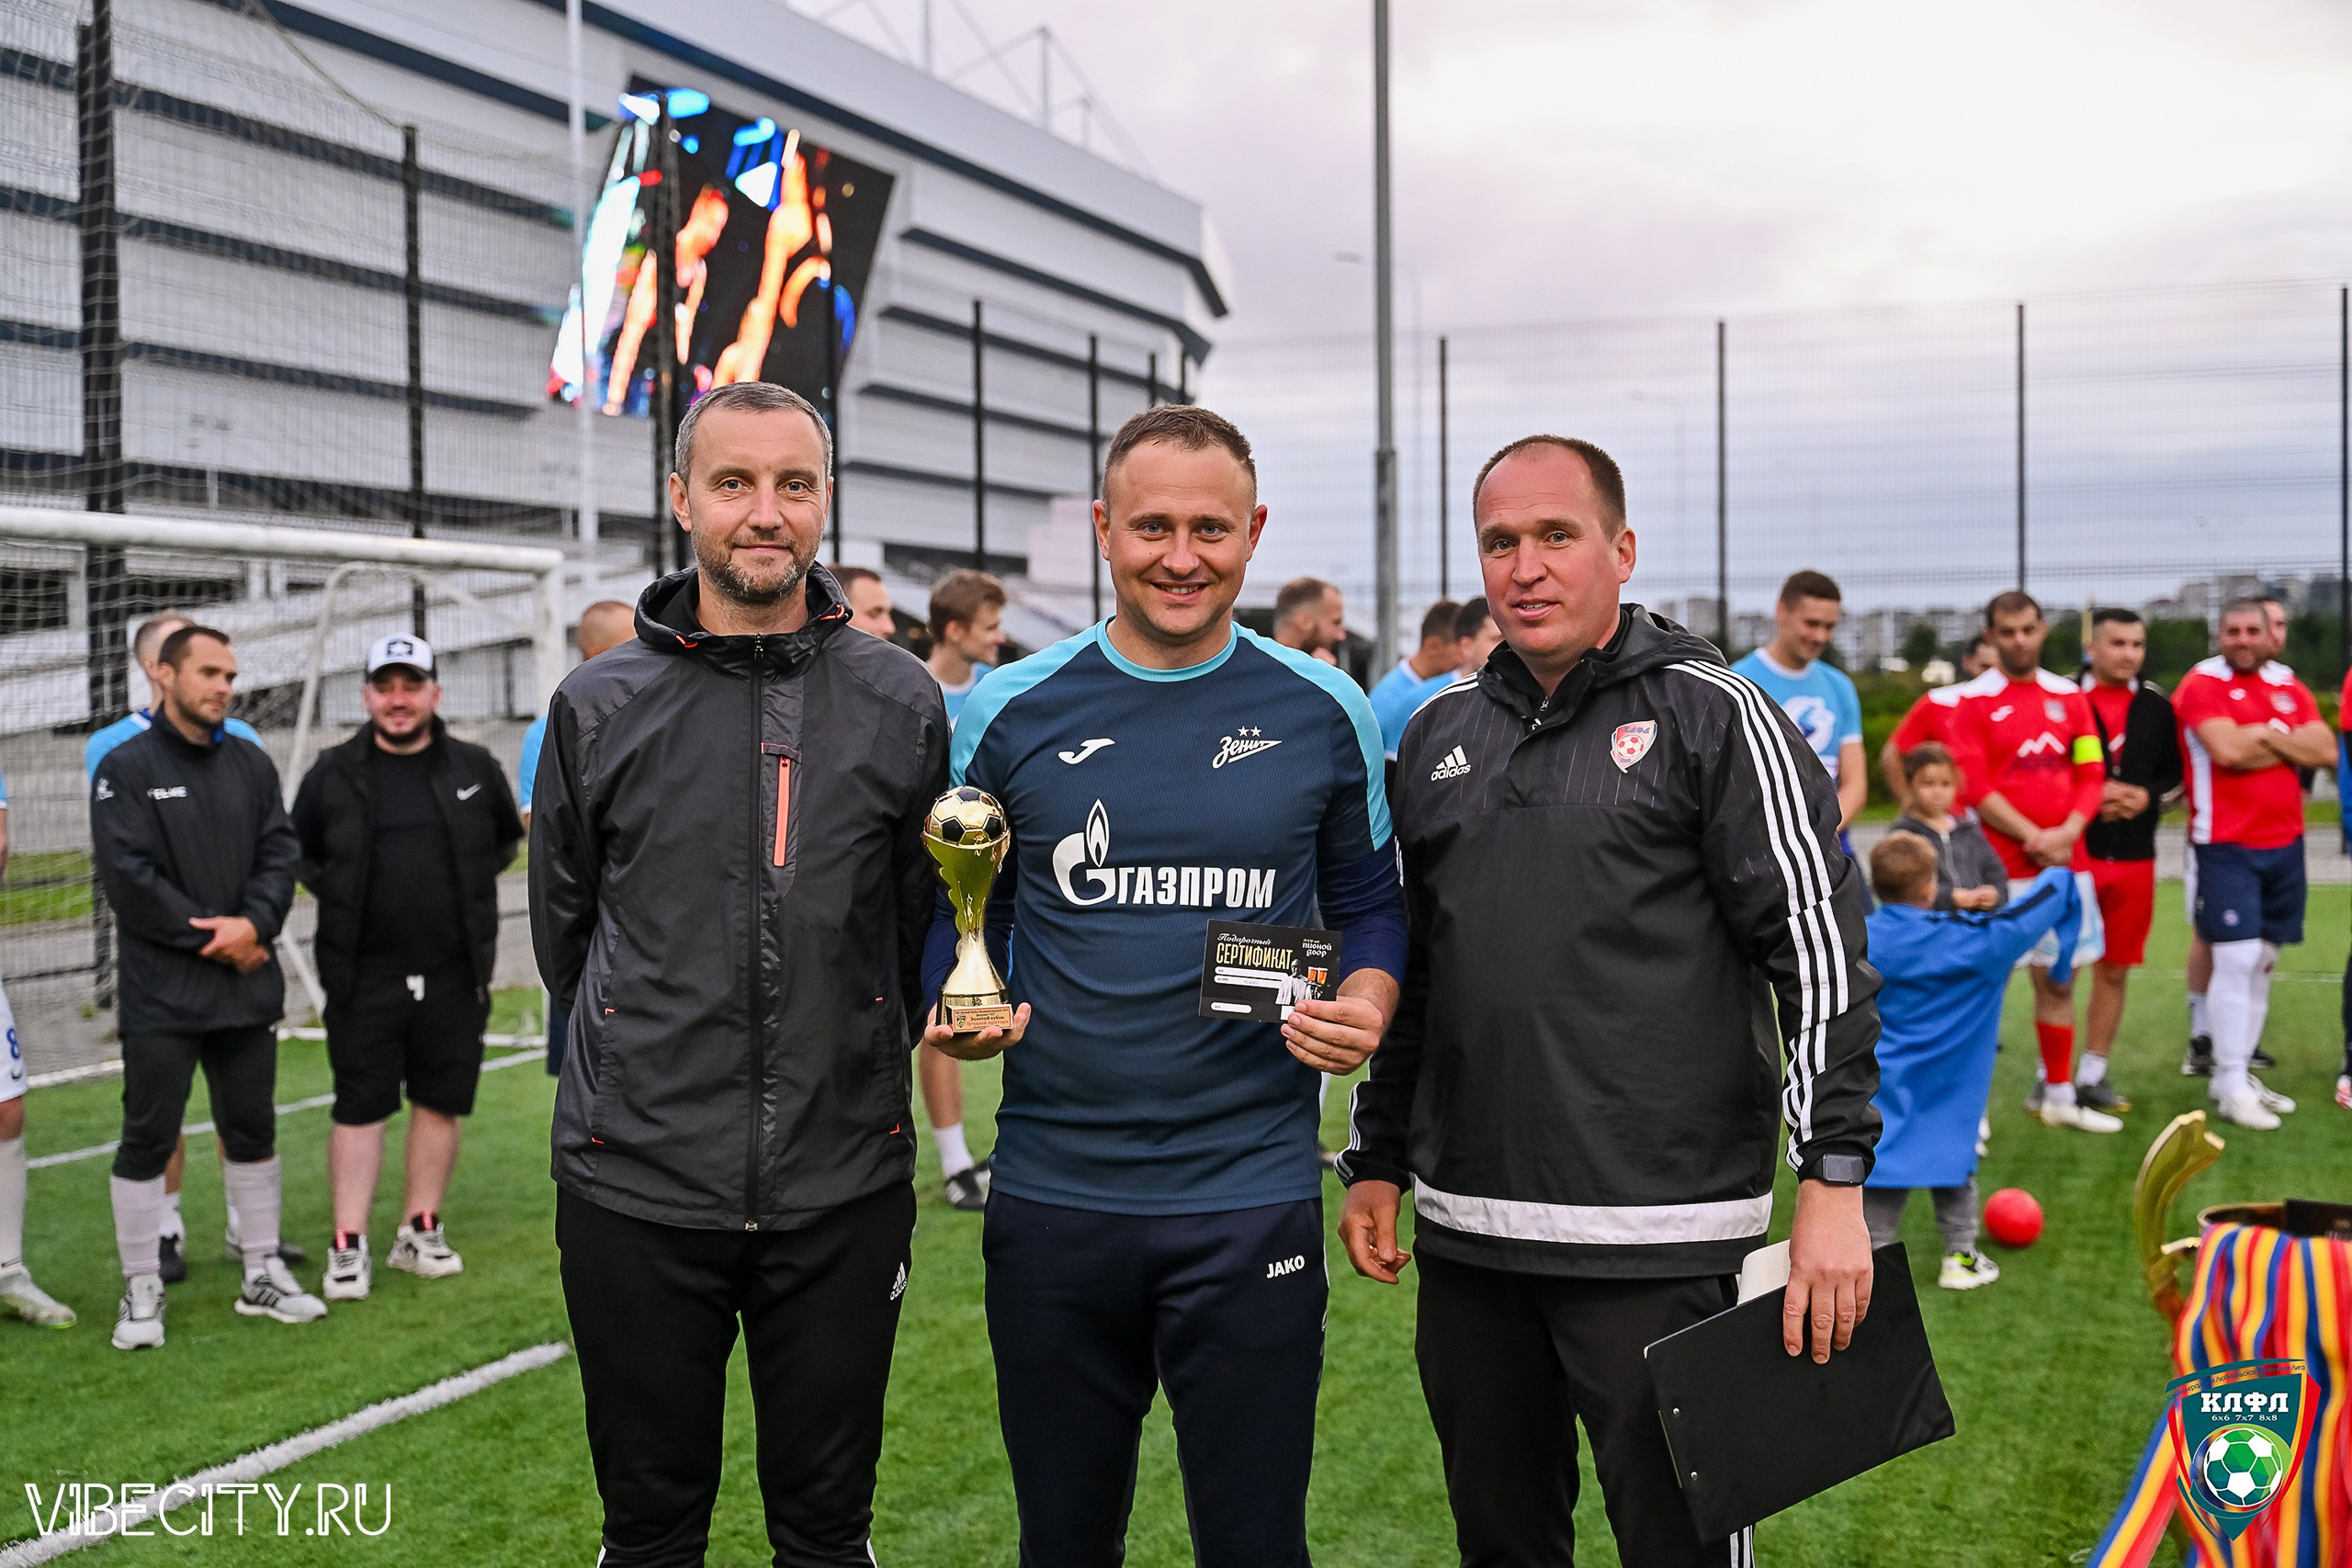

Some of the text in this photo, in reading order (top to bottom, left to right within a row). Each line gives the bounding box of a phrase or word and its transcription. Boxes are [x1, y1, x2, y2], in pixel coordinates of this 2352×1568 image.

[1430, 764, 1472, 782] adidas
[1116, 866, 1276, 908] ГАЗПРОМ
[1216, 932, 1272, 945] Подарочный
[1216, 942, 1294, 970] СЕРТИФИКАТ
[1266, 1255, 1305, 1279] JAKO
